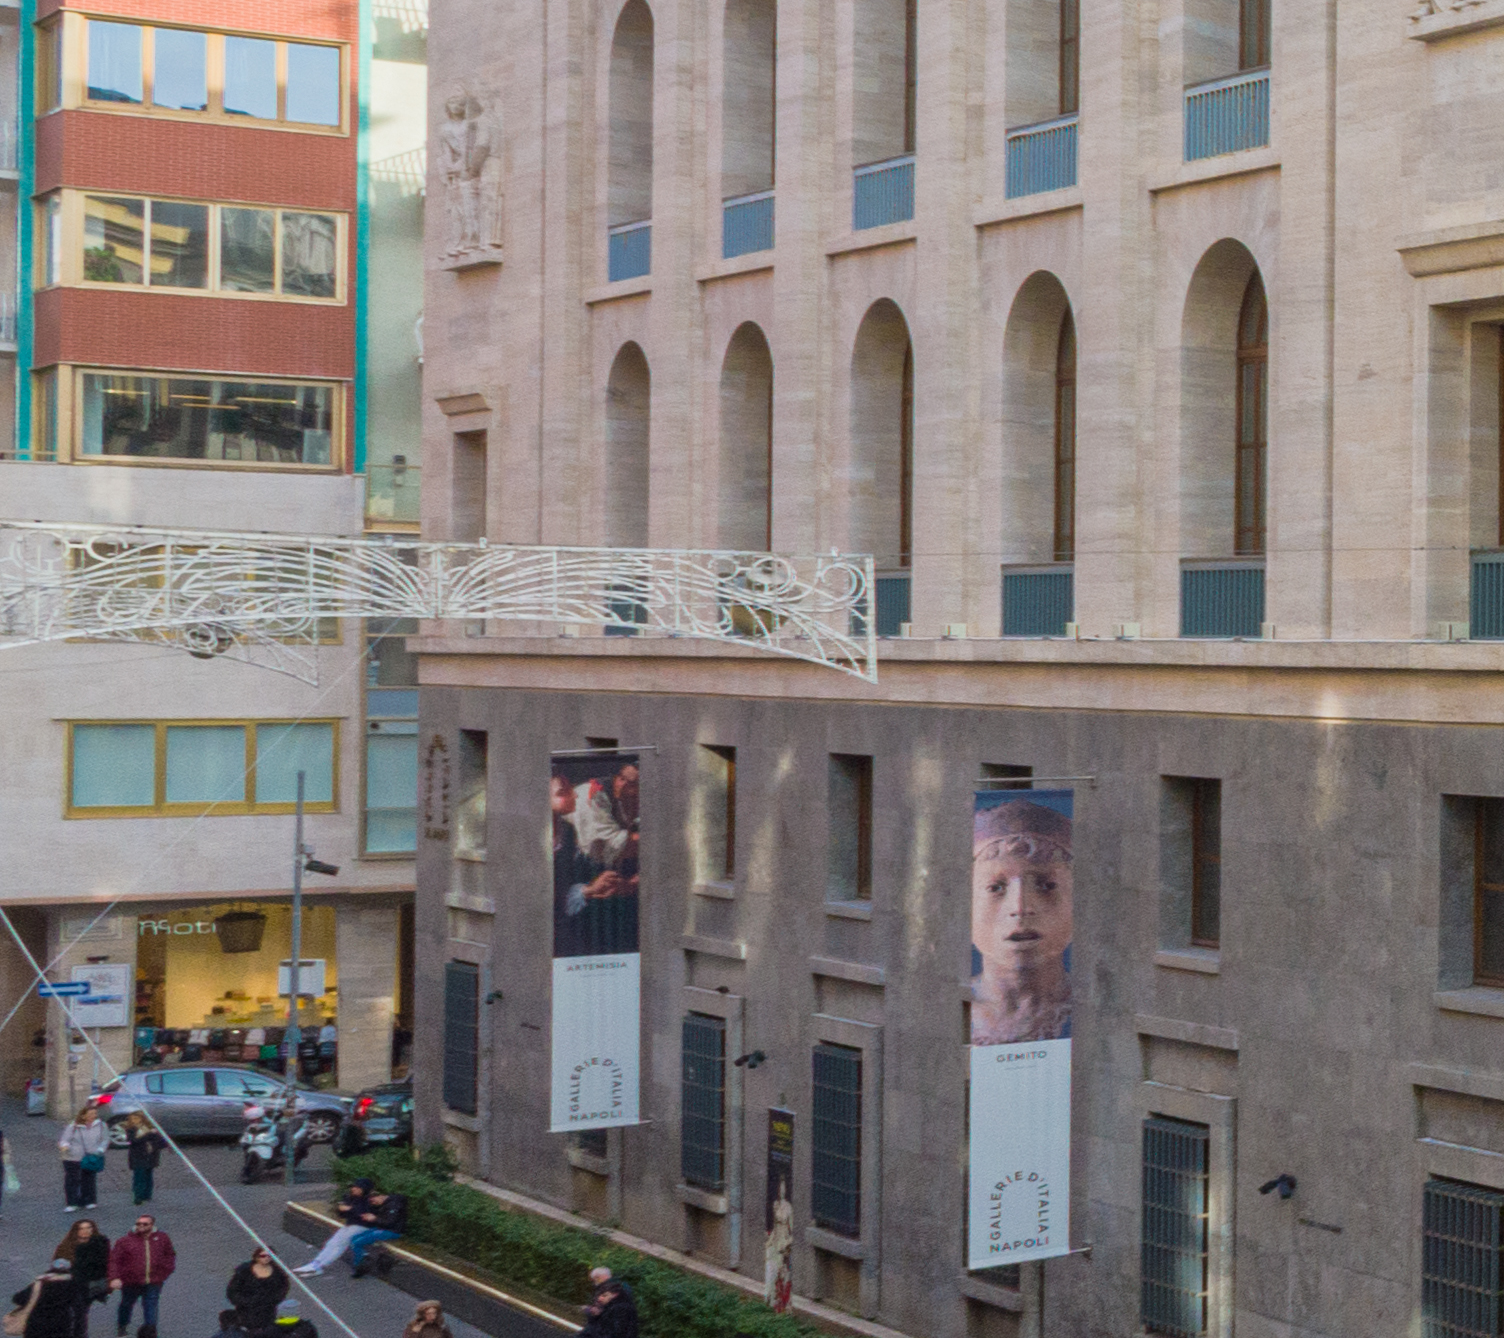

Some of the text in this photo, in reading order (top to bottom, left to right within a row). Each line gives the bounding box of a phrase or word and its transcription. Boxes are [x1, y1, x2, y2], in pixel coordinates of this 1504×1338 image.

[567, 962, 628, 972] ARTEMISIA
[996, 1050, 1048, 1063] GEMITO
[570, 1057, 599, 1112] GALLERIE
[569, 1110, 622, 1122] NAPOLI
[990, 1170, 1049, 1241] GALLERIE D'ITALIA
[989, 1236, 1050, 1253] NAPOLI
